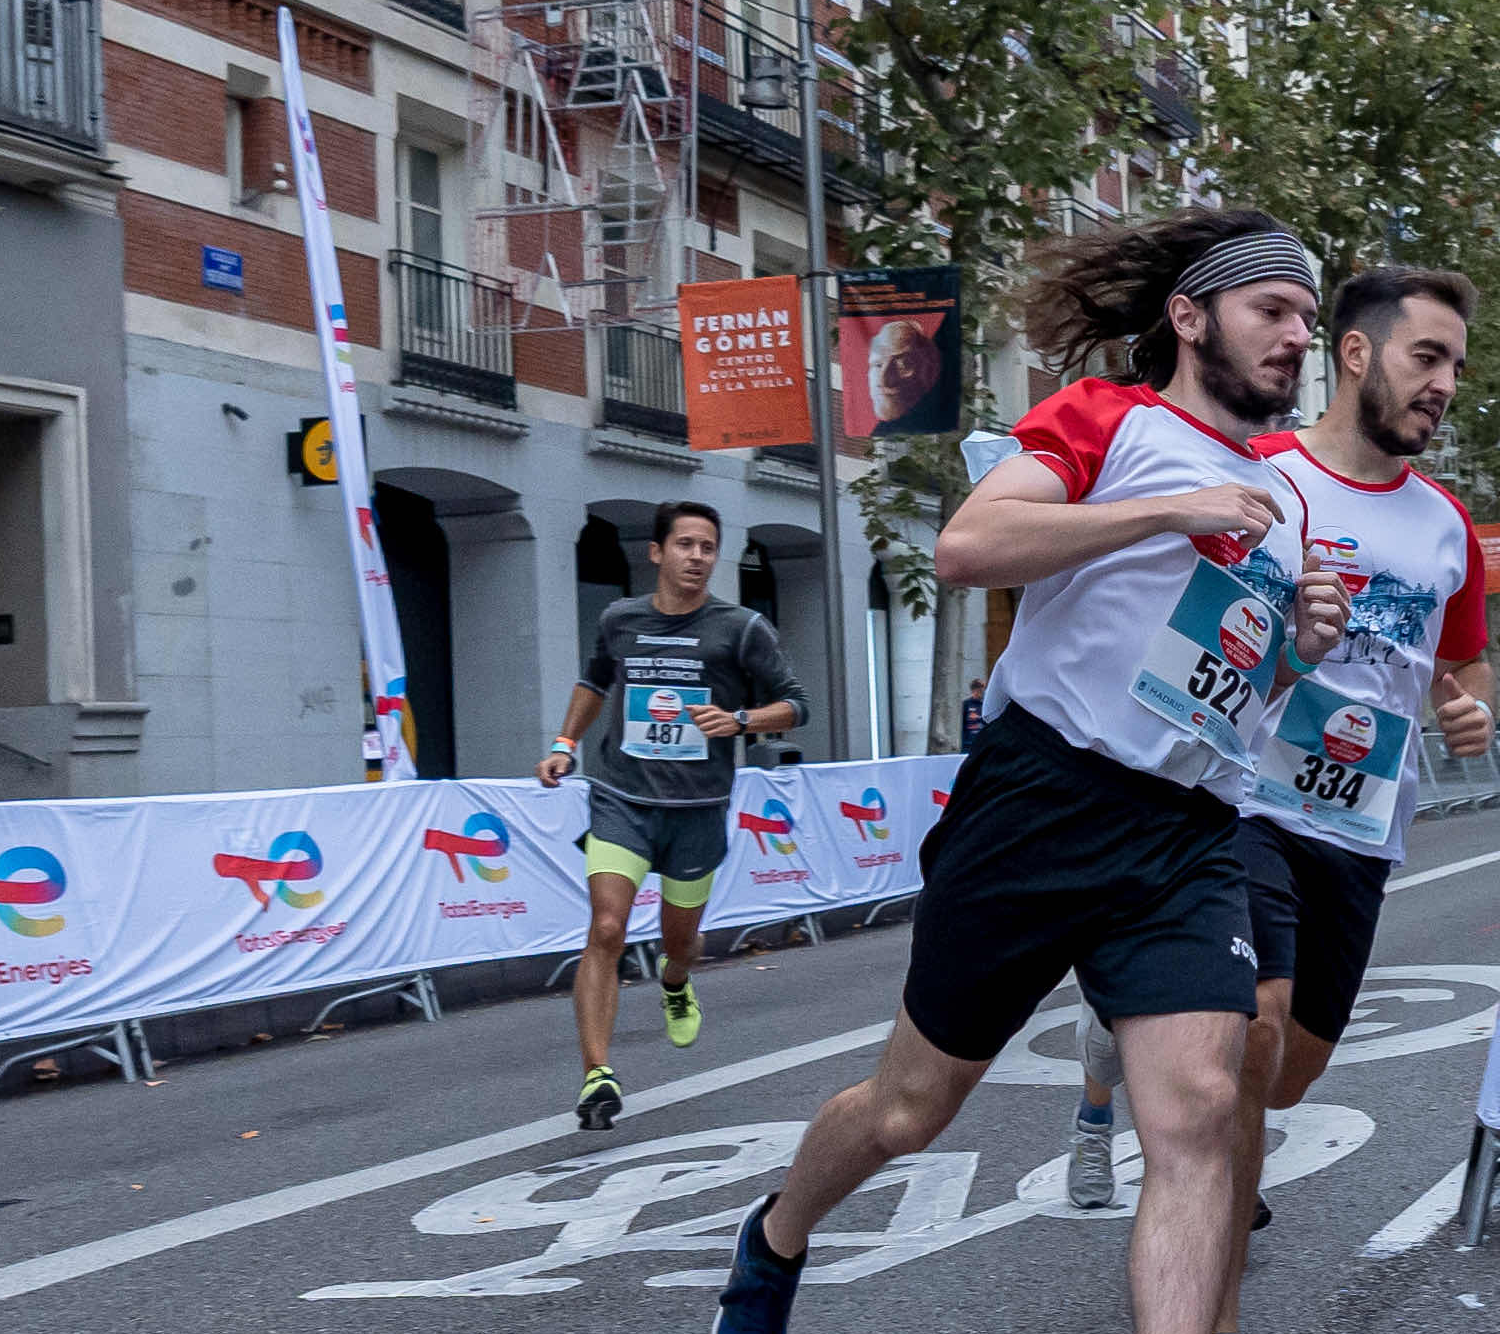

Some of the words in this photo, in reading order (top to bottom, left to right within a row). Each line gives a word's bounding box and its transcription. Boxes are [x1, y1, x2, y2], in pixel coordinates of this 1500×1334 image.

[694, 307, 789, 333] FERNÁN
[696, 330, 791, 353] GÓMEZ
[1187, 650, 1251, 726] 522
[646, 724, 684, 745] 487
[1295, 755, 1366, 808] 334
